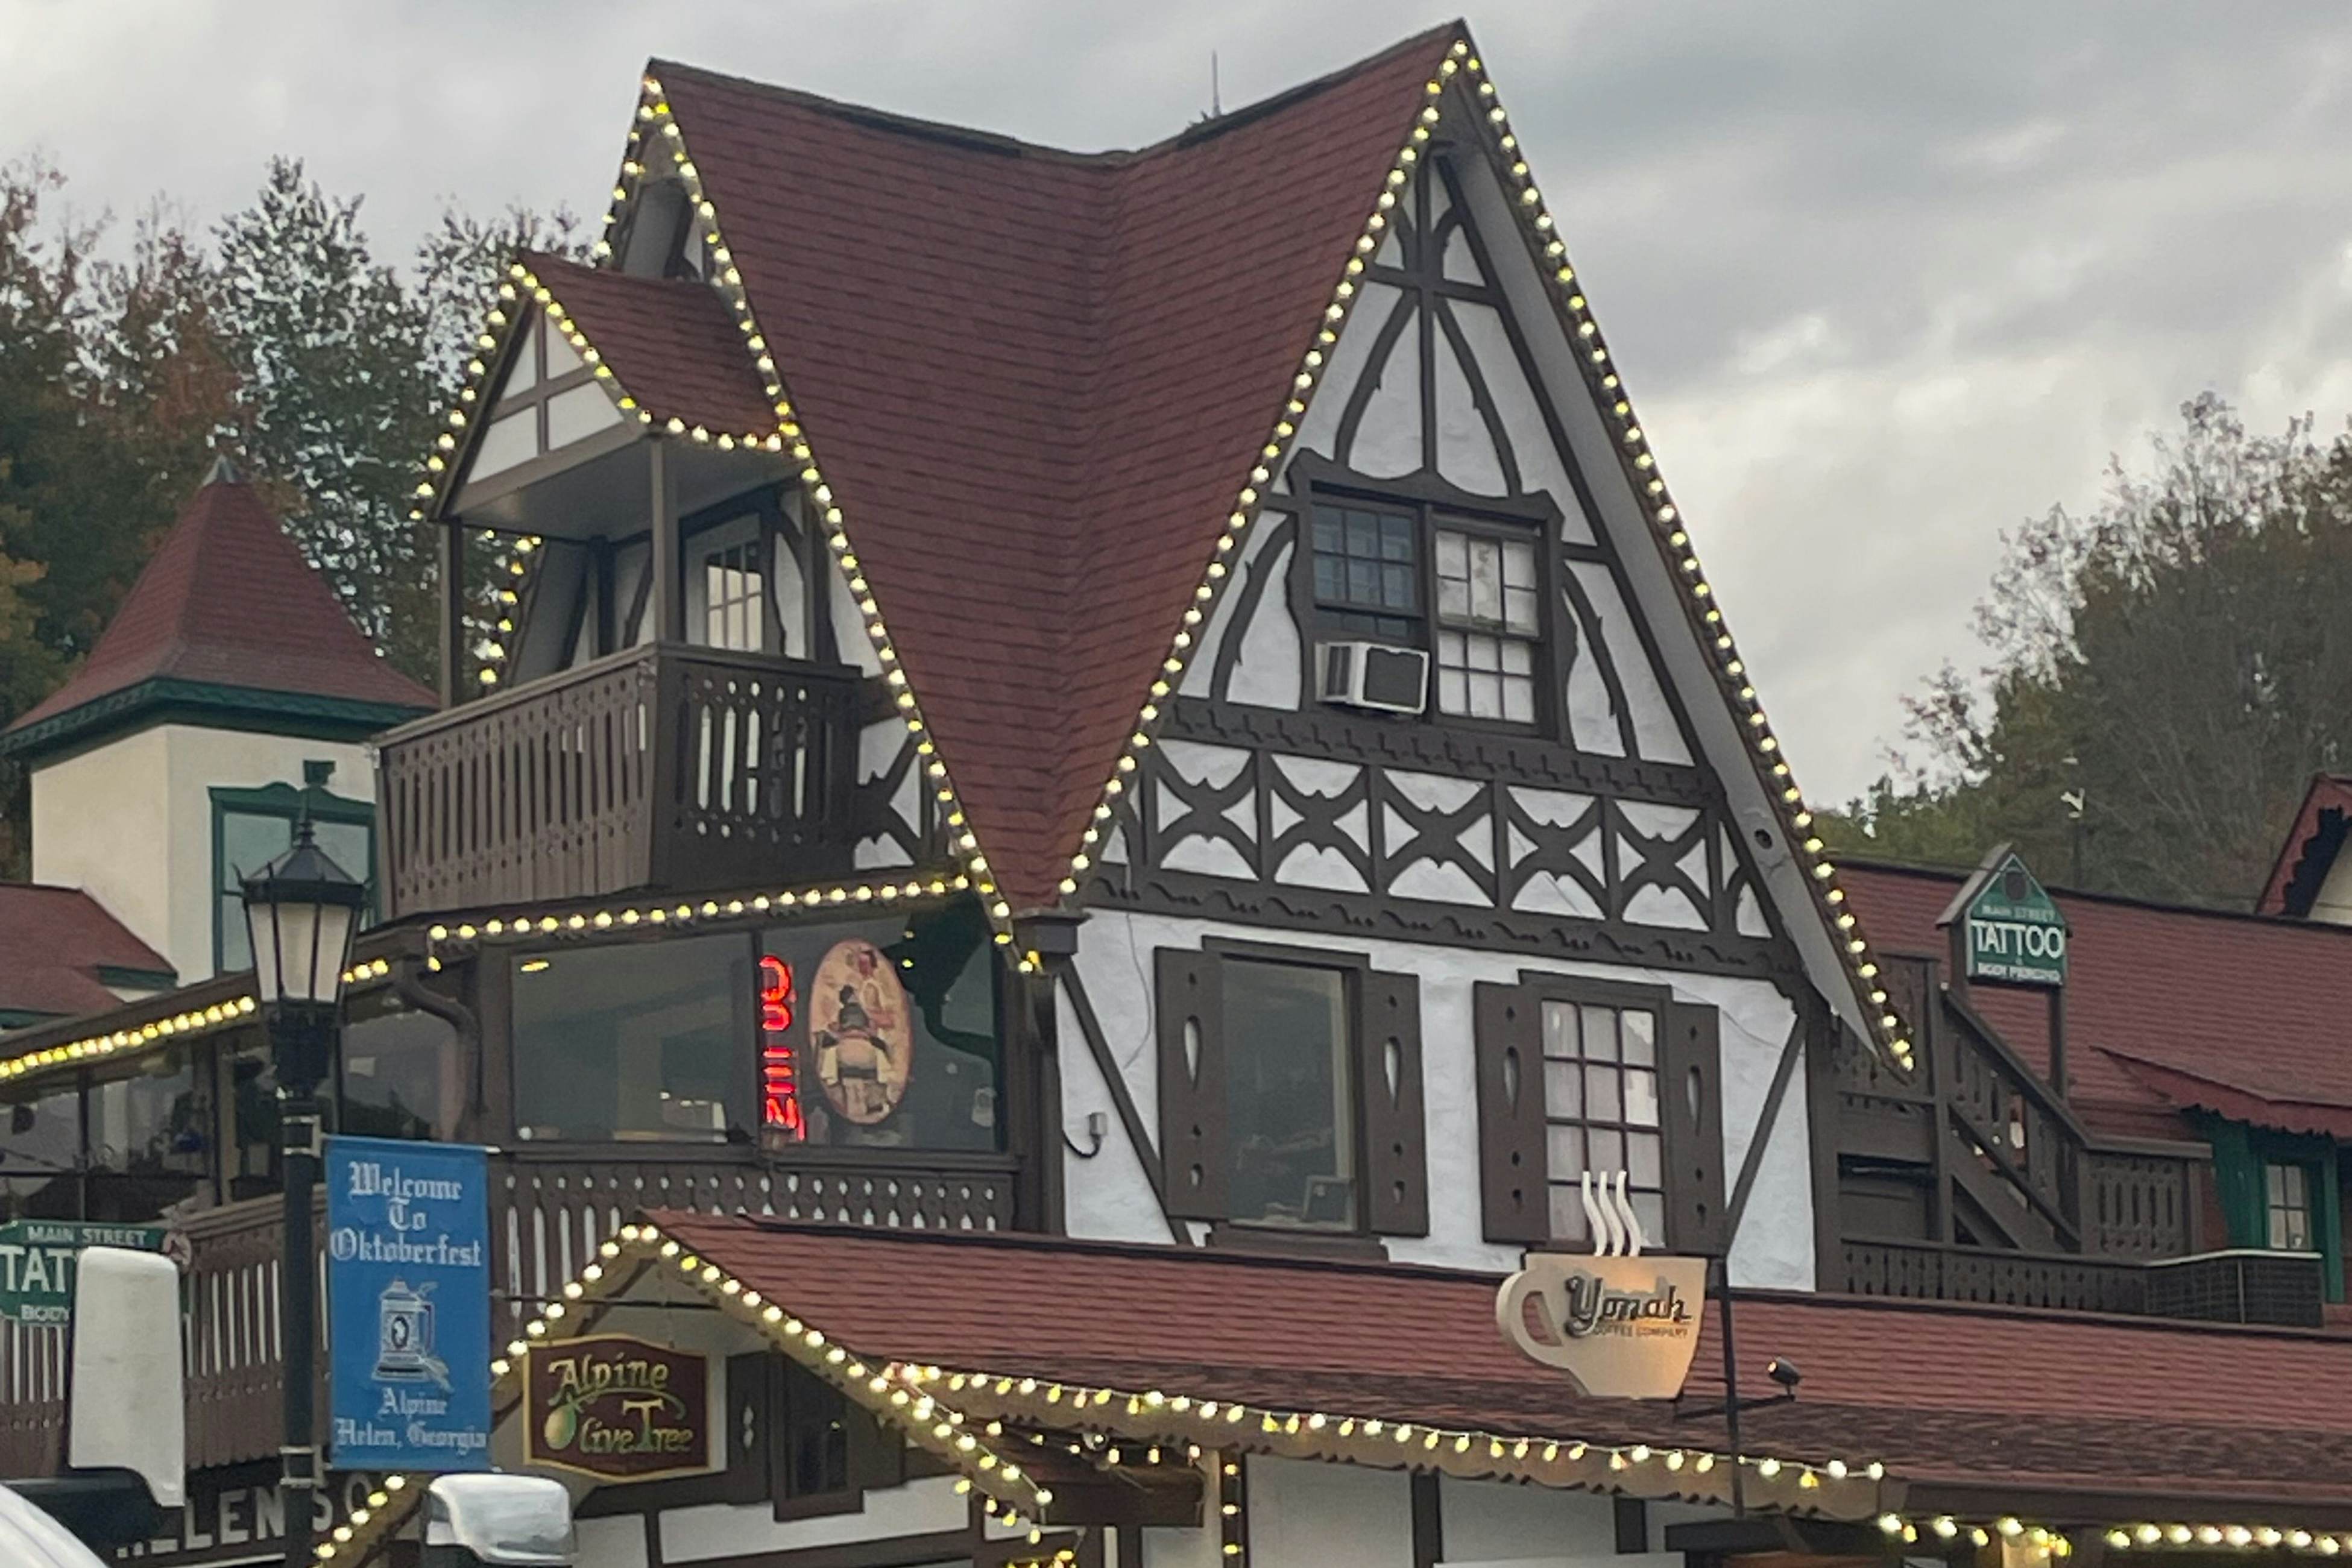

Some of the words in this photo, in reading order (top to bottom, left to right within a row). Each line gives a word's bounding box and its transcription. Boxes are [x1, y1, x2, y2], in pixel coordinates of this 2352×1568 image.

[1970, 920, 2064, 959] TATTOO
[348, 1161, 462, 1201] Welcome
[387, 1197, 427, 1231] To
[27, 1225, 74, 1242] MAIN
[82, 1227, 147, 1247] STREET
[330, 1226, 481, 1267] Oktoberfest
[0, 1244, 79, 1292] TAT
[1563, 1274, 1693, 1338] Yonah
[547, 1352, 669, 1406] Alpine
[376, 1387, 447, 1422] Alpine
[406, 1422, 487, 1456] Georgia
[622, 1397, 693, 1453] Tree
